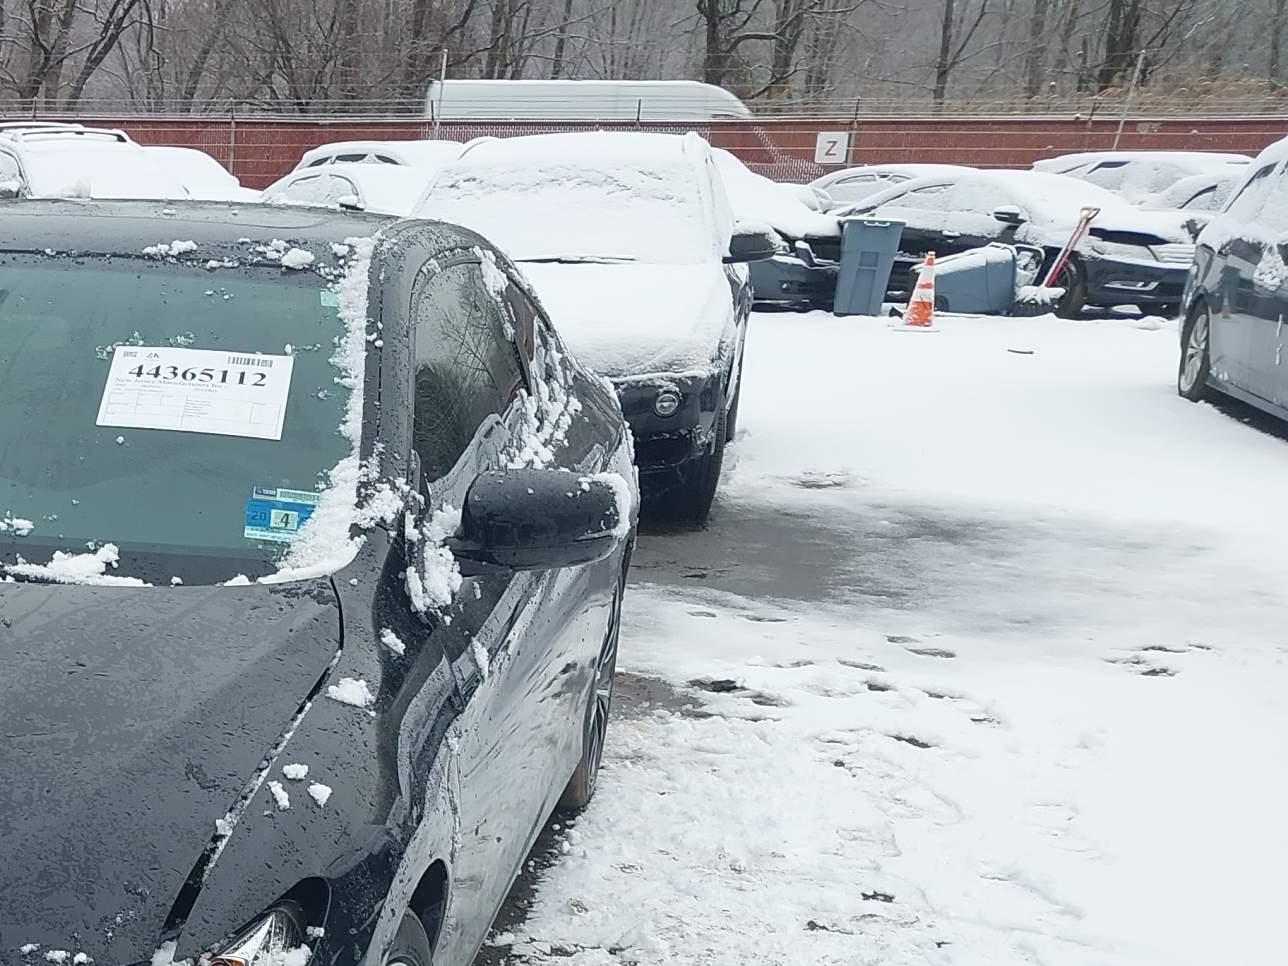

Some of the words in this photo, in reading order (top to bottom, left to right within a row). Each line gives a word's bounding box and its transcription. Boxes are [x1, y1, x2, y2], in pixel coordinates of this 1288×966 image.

[824, 140, 838, 156] Z
[128, 364, 267, 387] 44365112
[280, 513, 291, 528] 4
